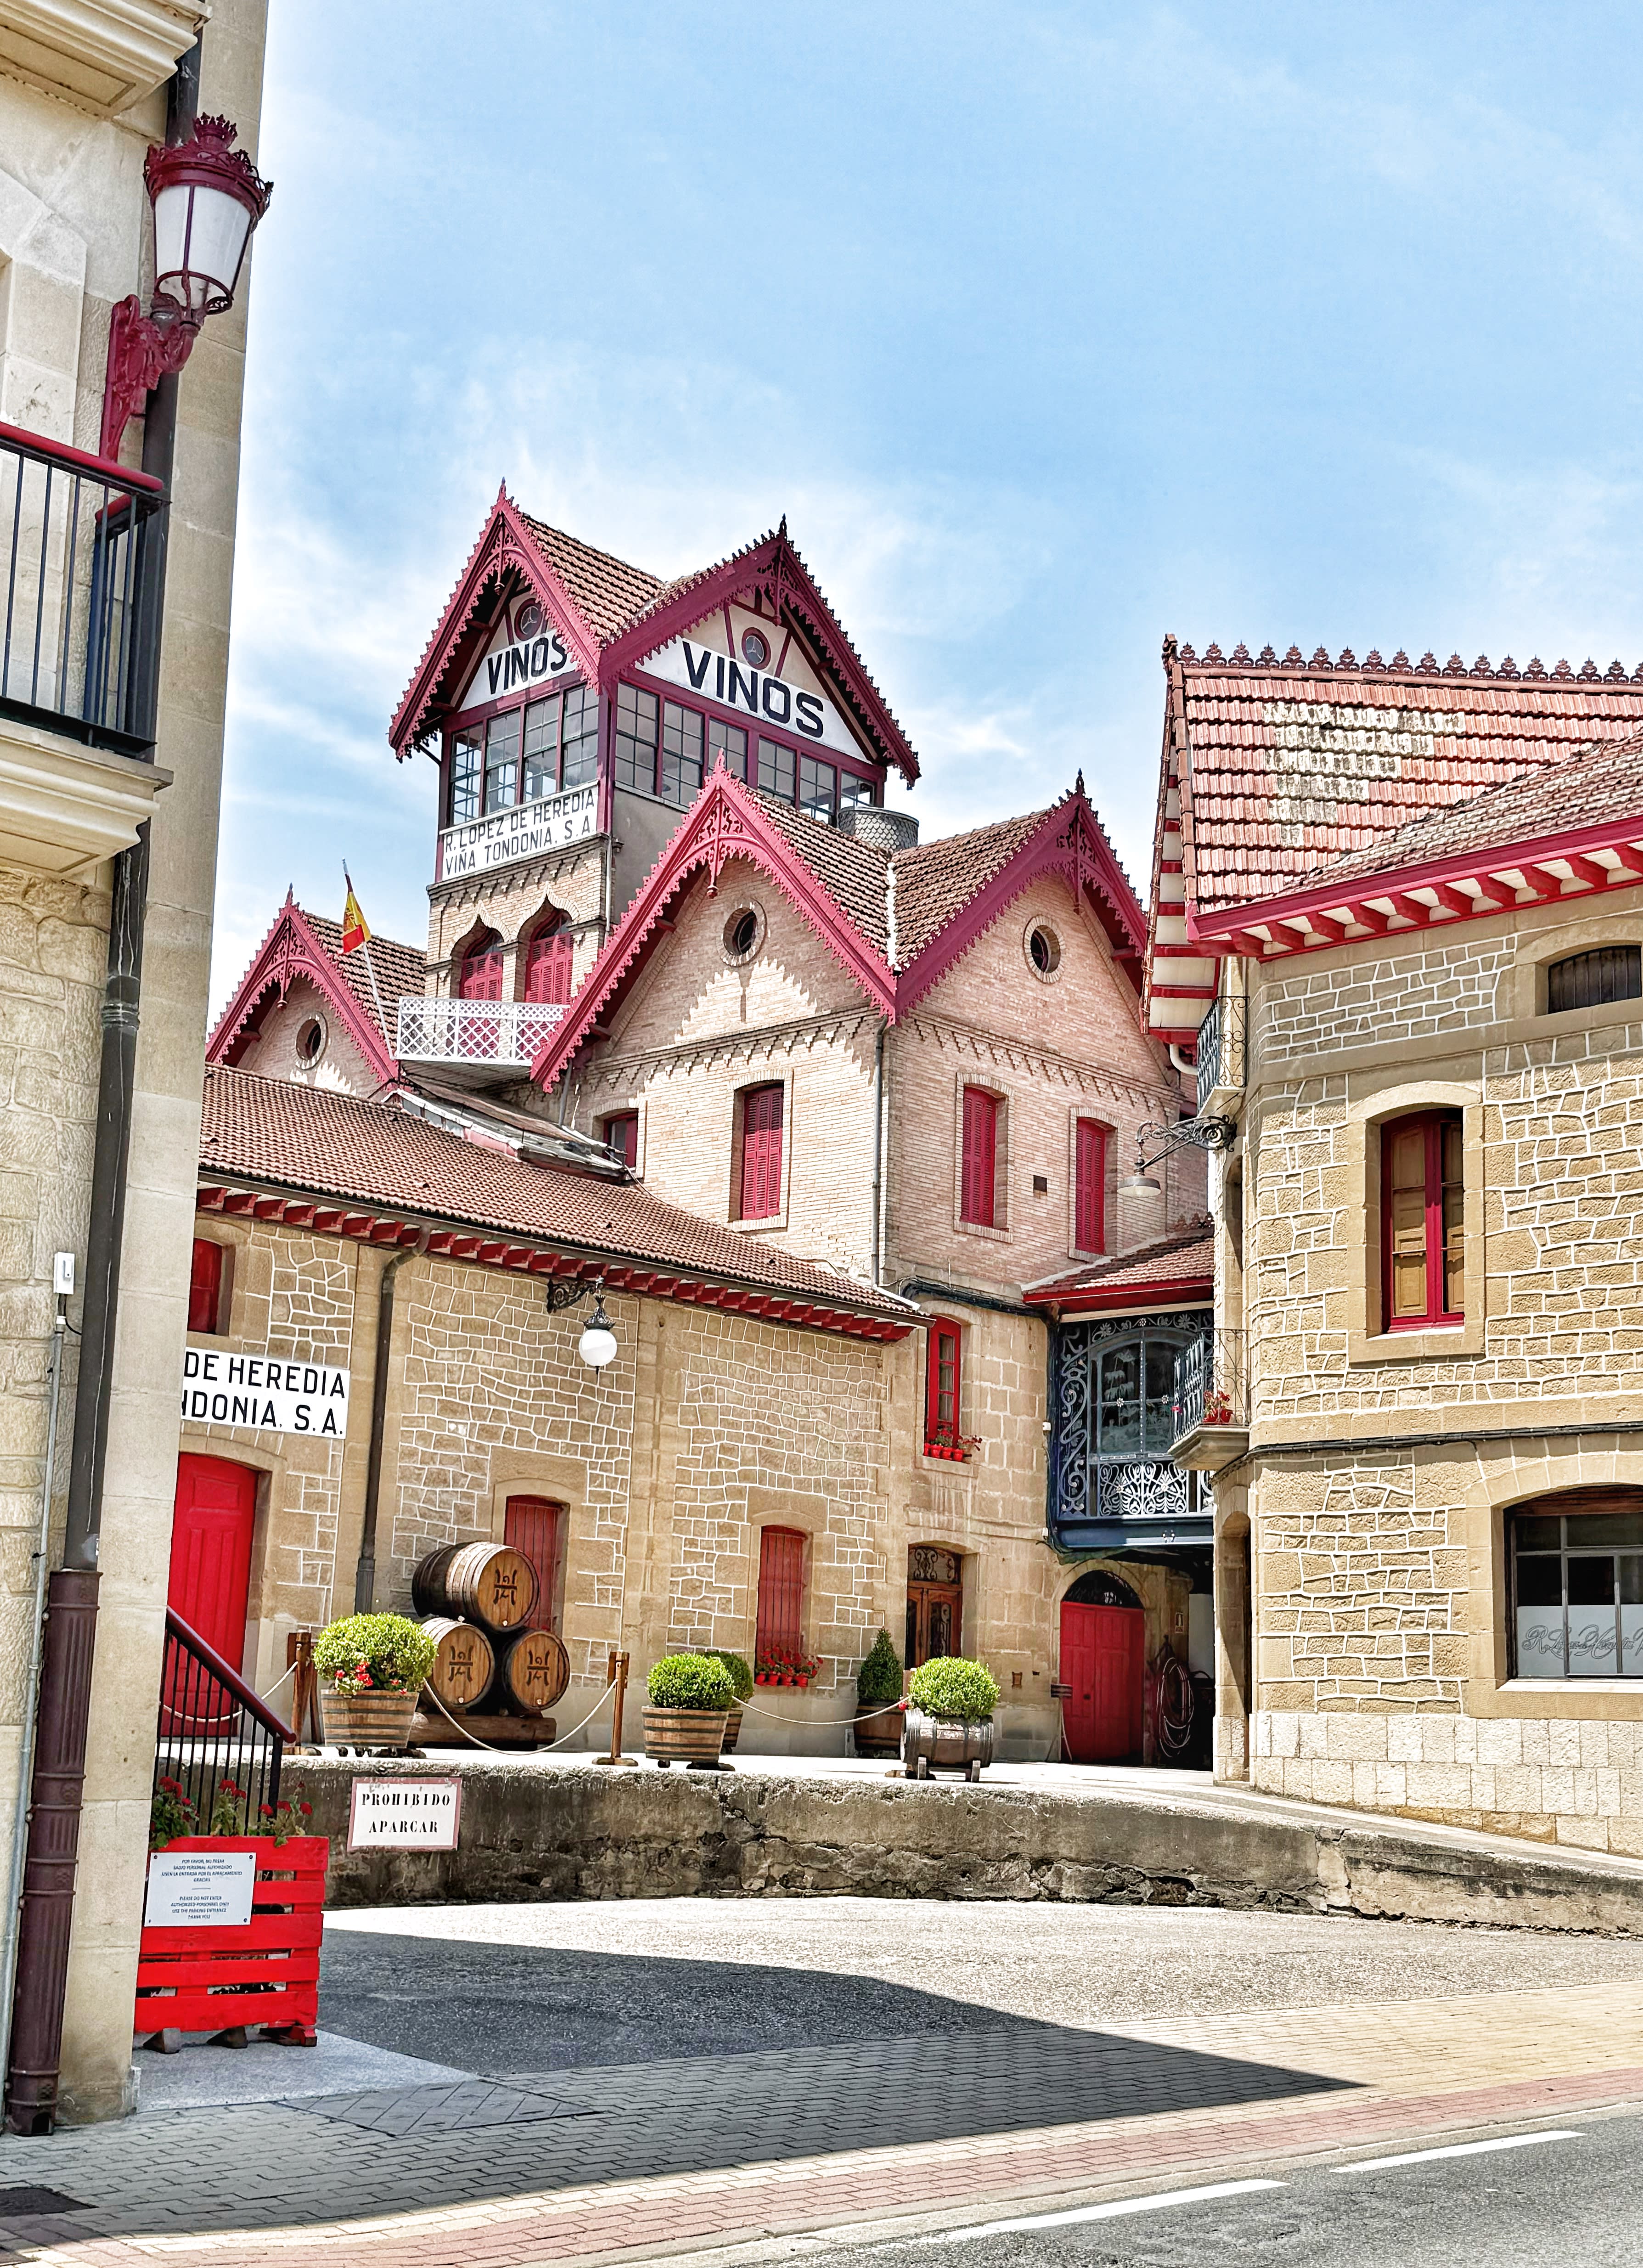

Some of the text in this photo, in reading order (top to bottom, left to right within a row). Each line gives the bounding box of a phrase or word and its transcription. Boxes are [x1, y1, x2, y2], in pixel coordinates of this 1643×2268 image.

[487, 634, 567, 695] VINOS
[682, 641, 824, 738] VINOS
[511, 809, 527, 832] DE
[534, 789, 594, 825] HEREDIA
[446, 849, 476, 875] VIÑA
[184, 1351, 345, 1398] DE HEREDIA
[362, 1794, 450, 1806] PROHIBIDO
[369, 1820, 437, 1833] APARCAR
